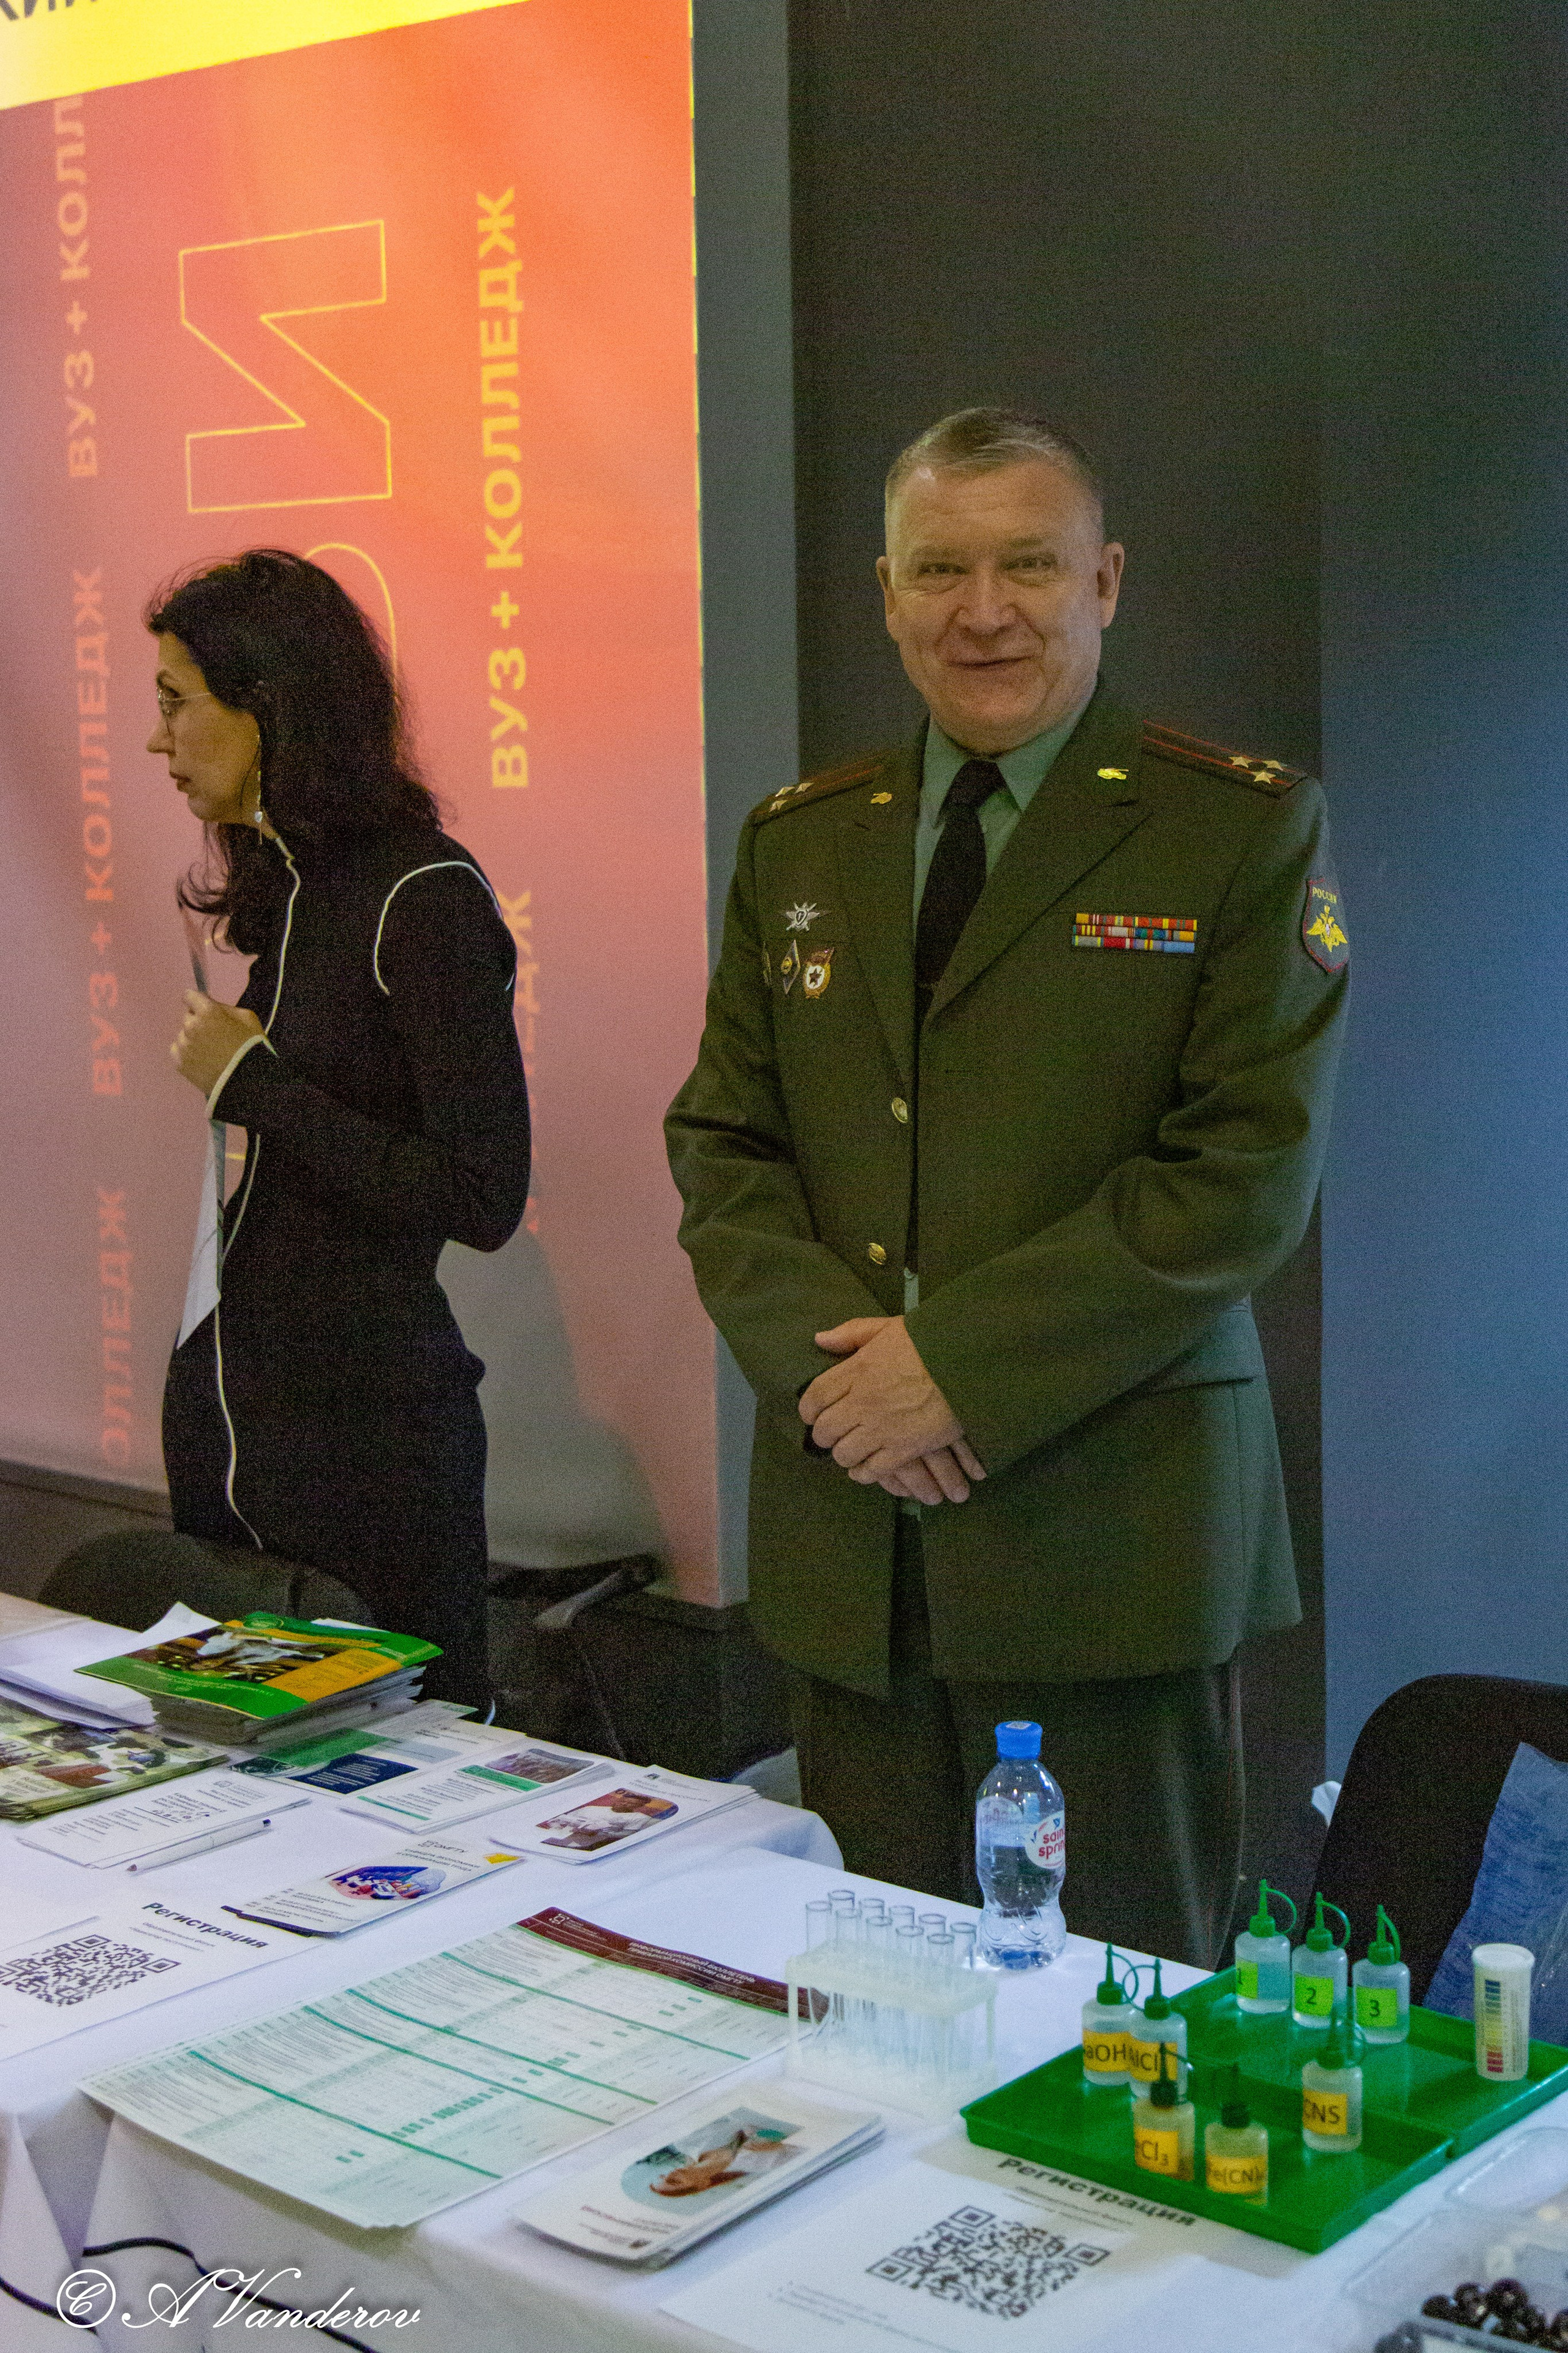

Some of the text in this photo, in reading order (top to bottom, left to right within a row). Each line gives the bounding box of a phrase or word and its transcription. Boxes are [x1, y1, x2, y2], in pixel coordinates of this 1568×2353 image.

[477, 186, 524, 569] КОЛЛЕДЖ
[64, 350, 98, 477] ВУЗ
[72, 567, 115, 901] КОЛЛЕДЖ
[488, 647, 528, 788] ВУЗ
[89, 972, 122, 1095] ВУЗ
[1038, 1840, 1066, 1860] sprin
[1043, 1829, 1066, 1845] sain
[141, 1902, 269, 1948] Регистрация
[1307, 1987, 1317, 2005] 2
[1370, 1999, 1381, 2017] 3
[1084, 2043, 1126, 2062] aOH
[998, 2158, 1197, 2226] Регистрация
